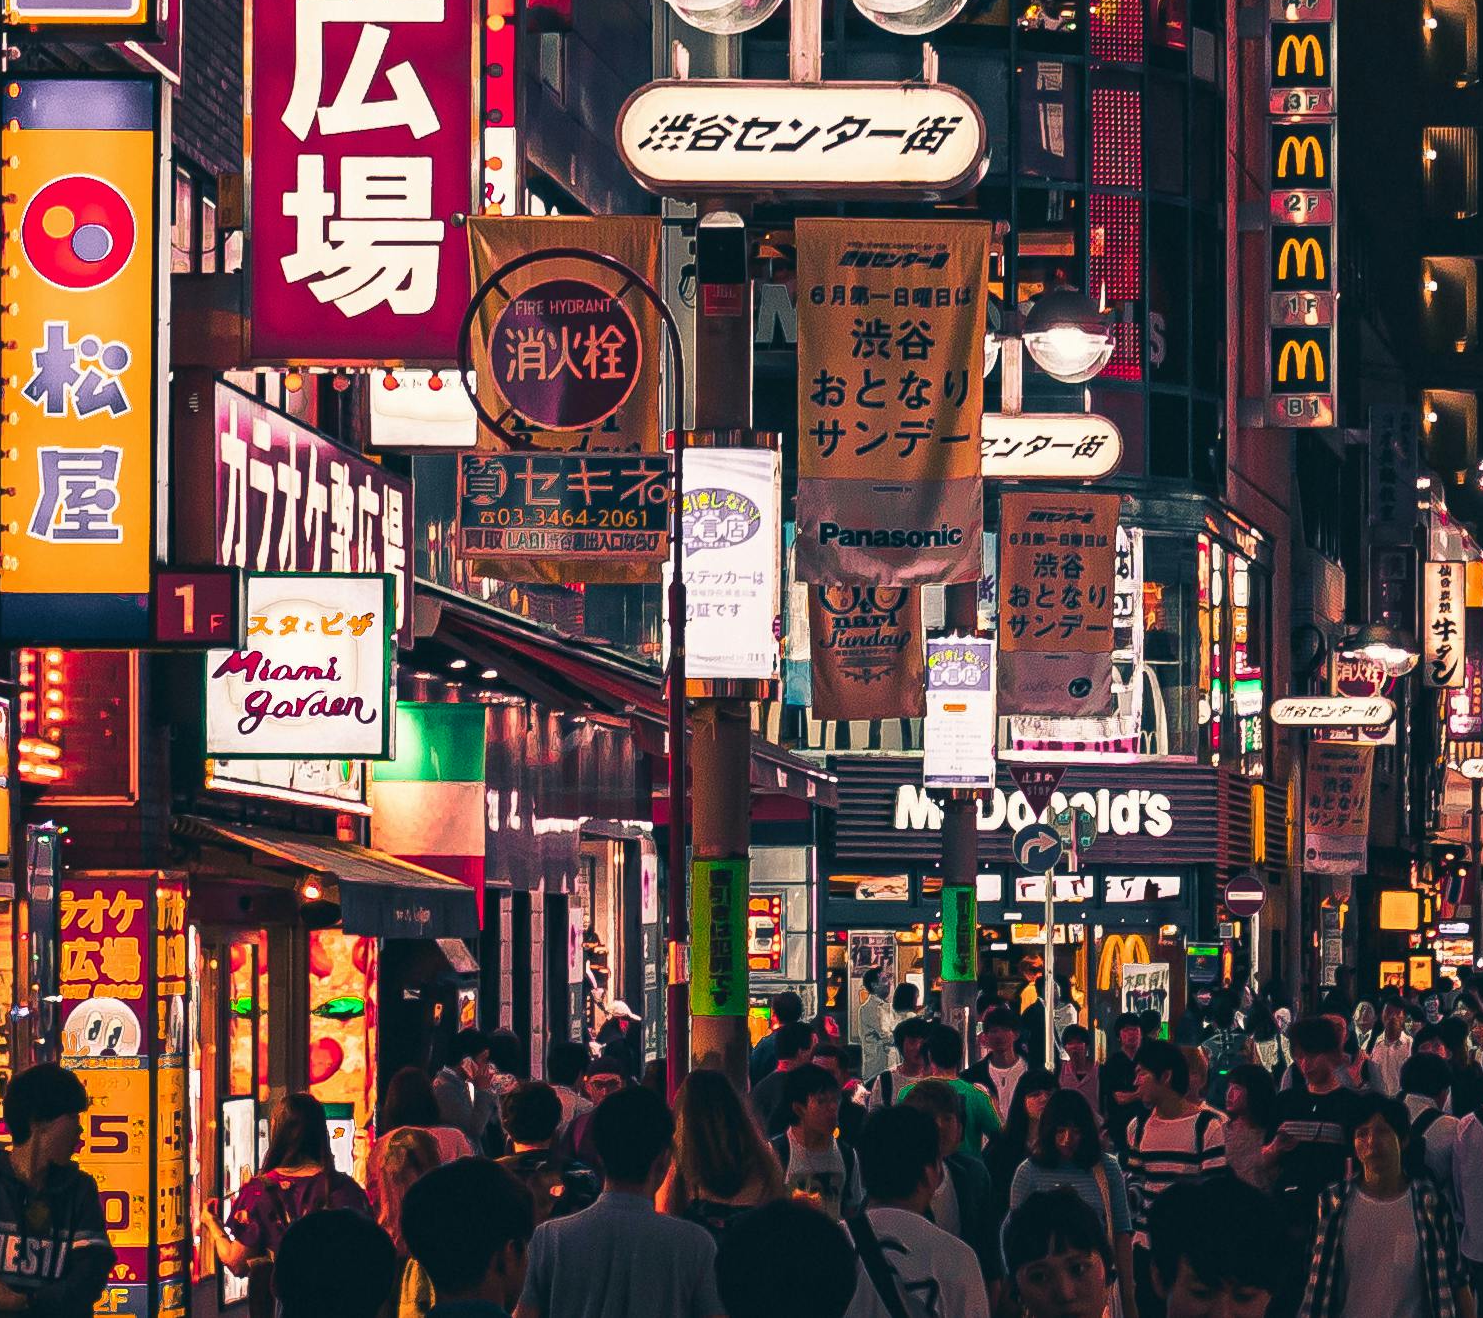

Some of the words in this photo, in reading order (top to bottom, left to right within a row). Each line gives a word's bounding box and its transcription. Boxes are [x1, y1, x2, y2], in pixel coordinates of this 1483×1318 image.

[1286, 90, 1318, 111] 3F
[638, 114, 965, 157] 渋谷センター街
[1286, 192, 1318, 213] 2F
[515, 300, 545, 317] FIRE
[548, 297, 614, 315] HYDRANT
[809, 284, 973, 309] 6月第一日曜日は
[1287, 295, 1318, 316] 1F
[504, 324, 627, 383] 消火栓
[849, 317, 936, 361] 渋谷
[809, 368, 970, 410] おとなり
[1287, 397, 1320, 418] B1
[20, 319, 133, 545] 松屋
[809, 418, 972, 459] サンデー
[514, 457, 670, 506] セキネ
[496, 508, 649, 528] 03-3464-2061
[818, 521, 966, 551] Panasonic
[1032, 552, 1086, 581] 渋谷
[1007, 586, 1108, 610] おとなり
[1007, 615, 1110, 639] サンデー
[212, 649, 341, 684] Miami
[61, 936, 142, 983] 広場
